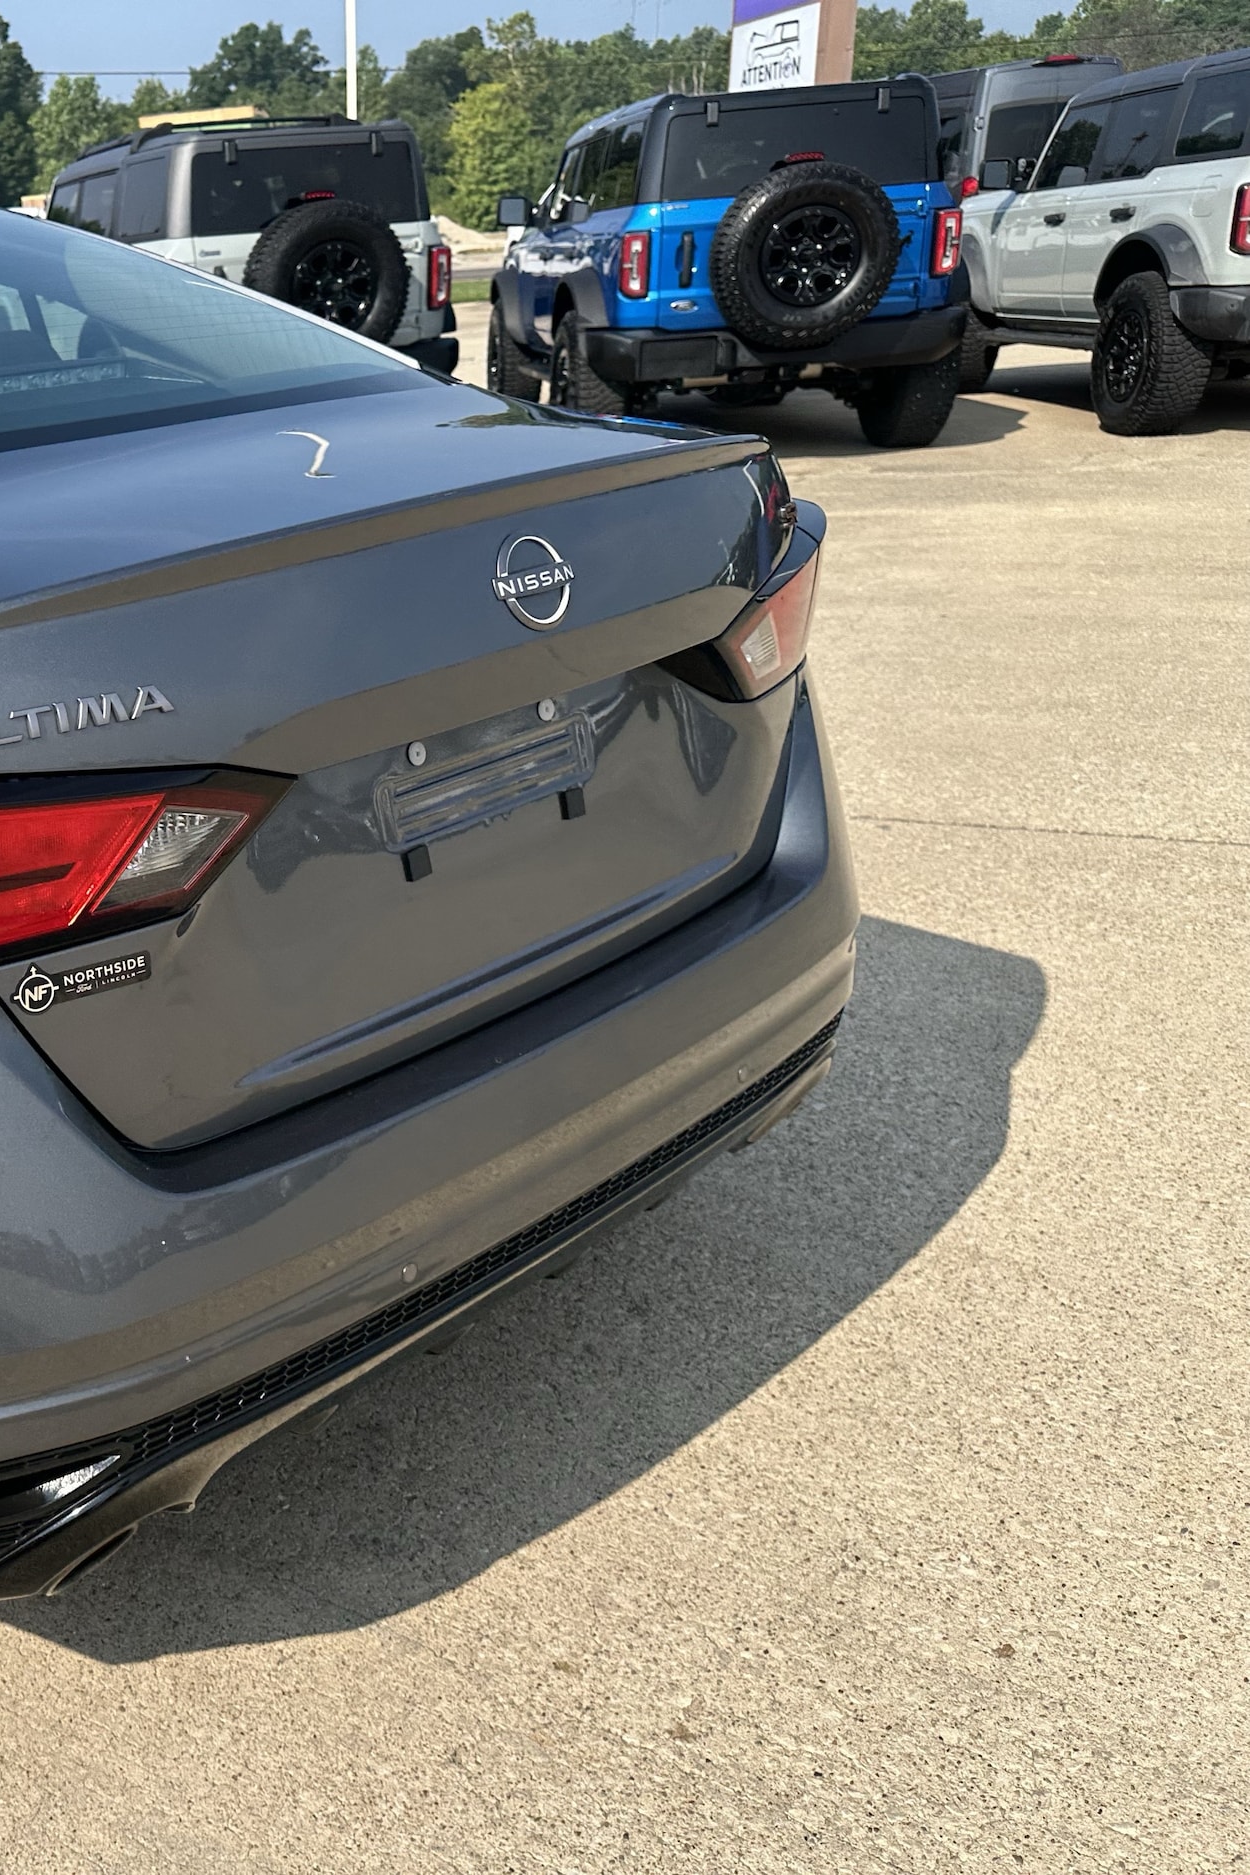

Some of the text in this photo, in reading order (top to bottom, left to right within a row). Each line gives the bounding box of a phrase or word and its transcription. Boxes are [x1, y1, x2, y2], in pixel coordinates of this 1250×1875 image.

[497, 564, 575, 597] NISSAN
[63, 955, 146, 987] NORTHSIDE
[101, 972, 137, 985] LINCOLN
[24, 983, 52, 1009] NF
